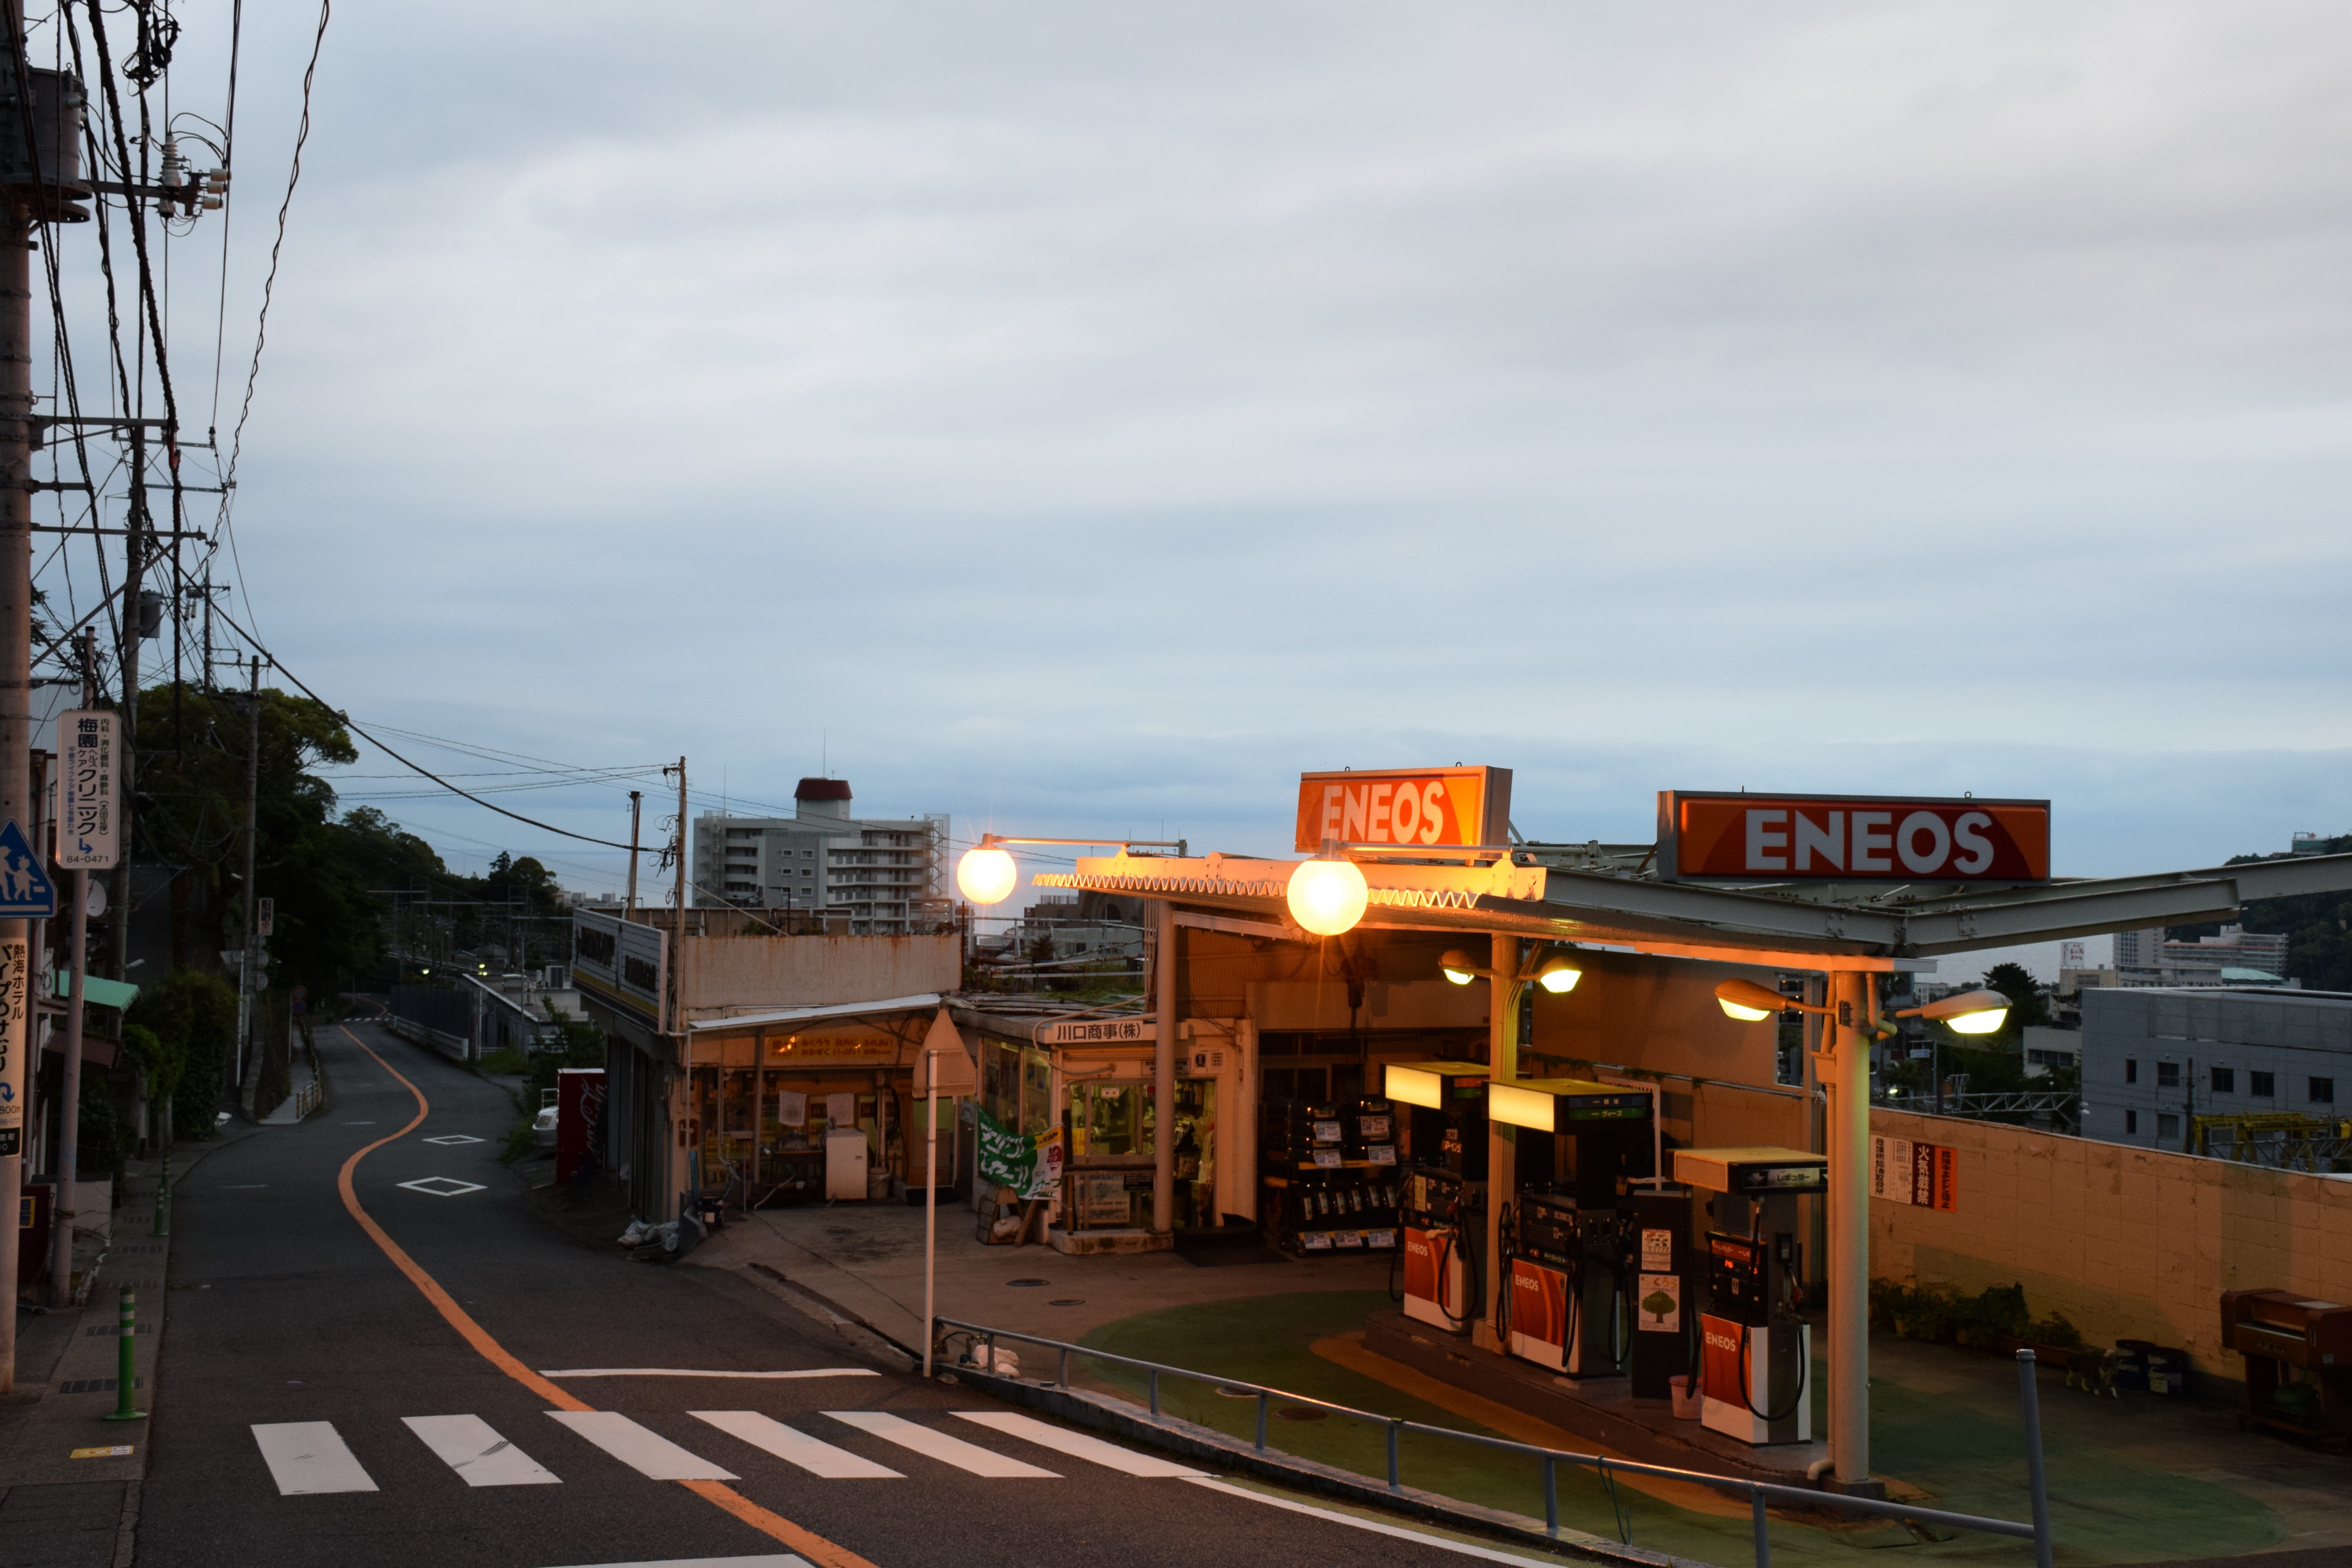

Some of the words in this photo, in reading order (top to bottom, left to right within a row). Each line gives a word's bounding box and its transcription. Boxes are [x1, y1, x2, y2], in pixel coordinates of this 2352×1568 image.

[1321, 781, 1444, 845] ENEOS
[1746, 809, 1994, 874] ENEOS
[1057, 1023, 1140, 1040] 川口商事(株)
[1408, 1241, 1428, 1257] ENEOS
[1515, 1274, 1539, 1292] ENEOS
[1706, 1331, 1736, 1352] ENEOS
